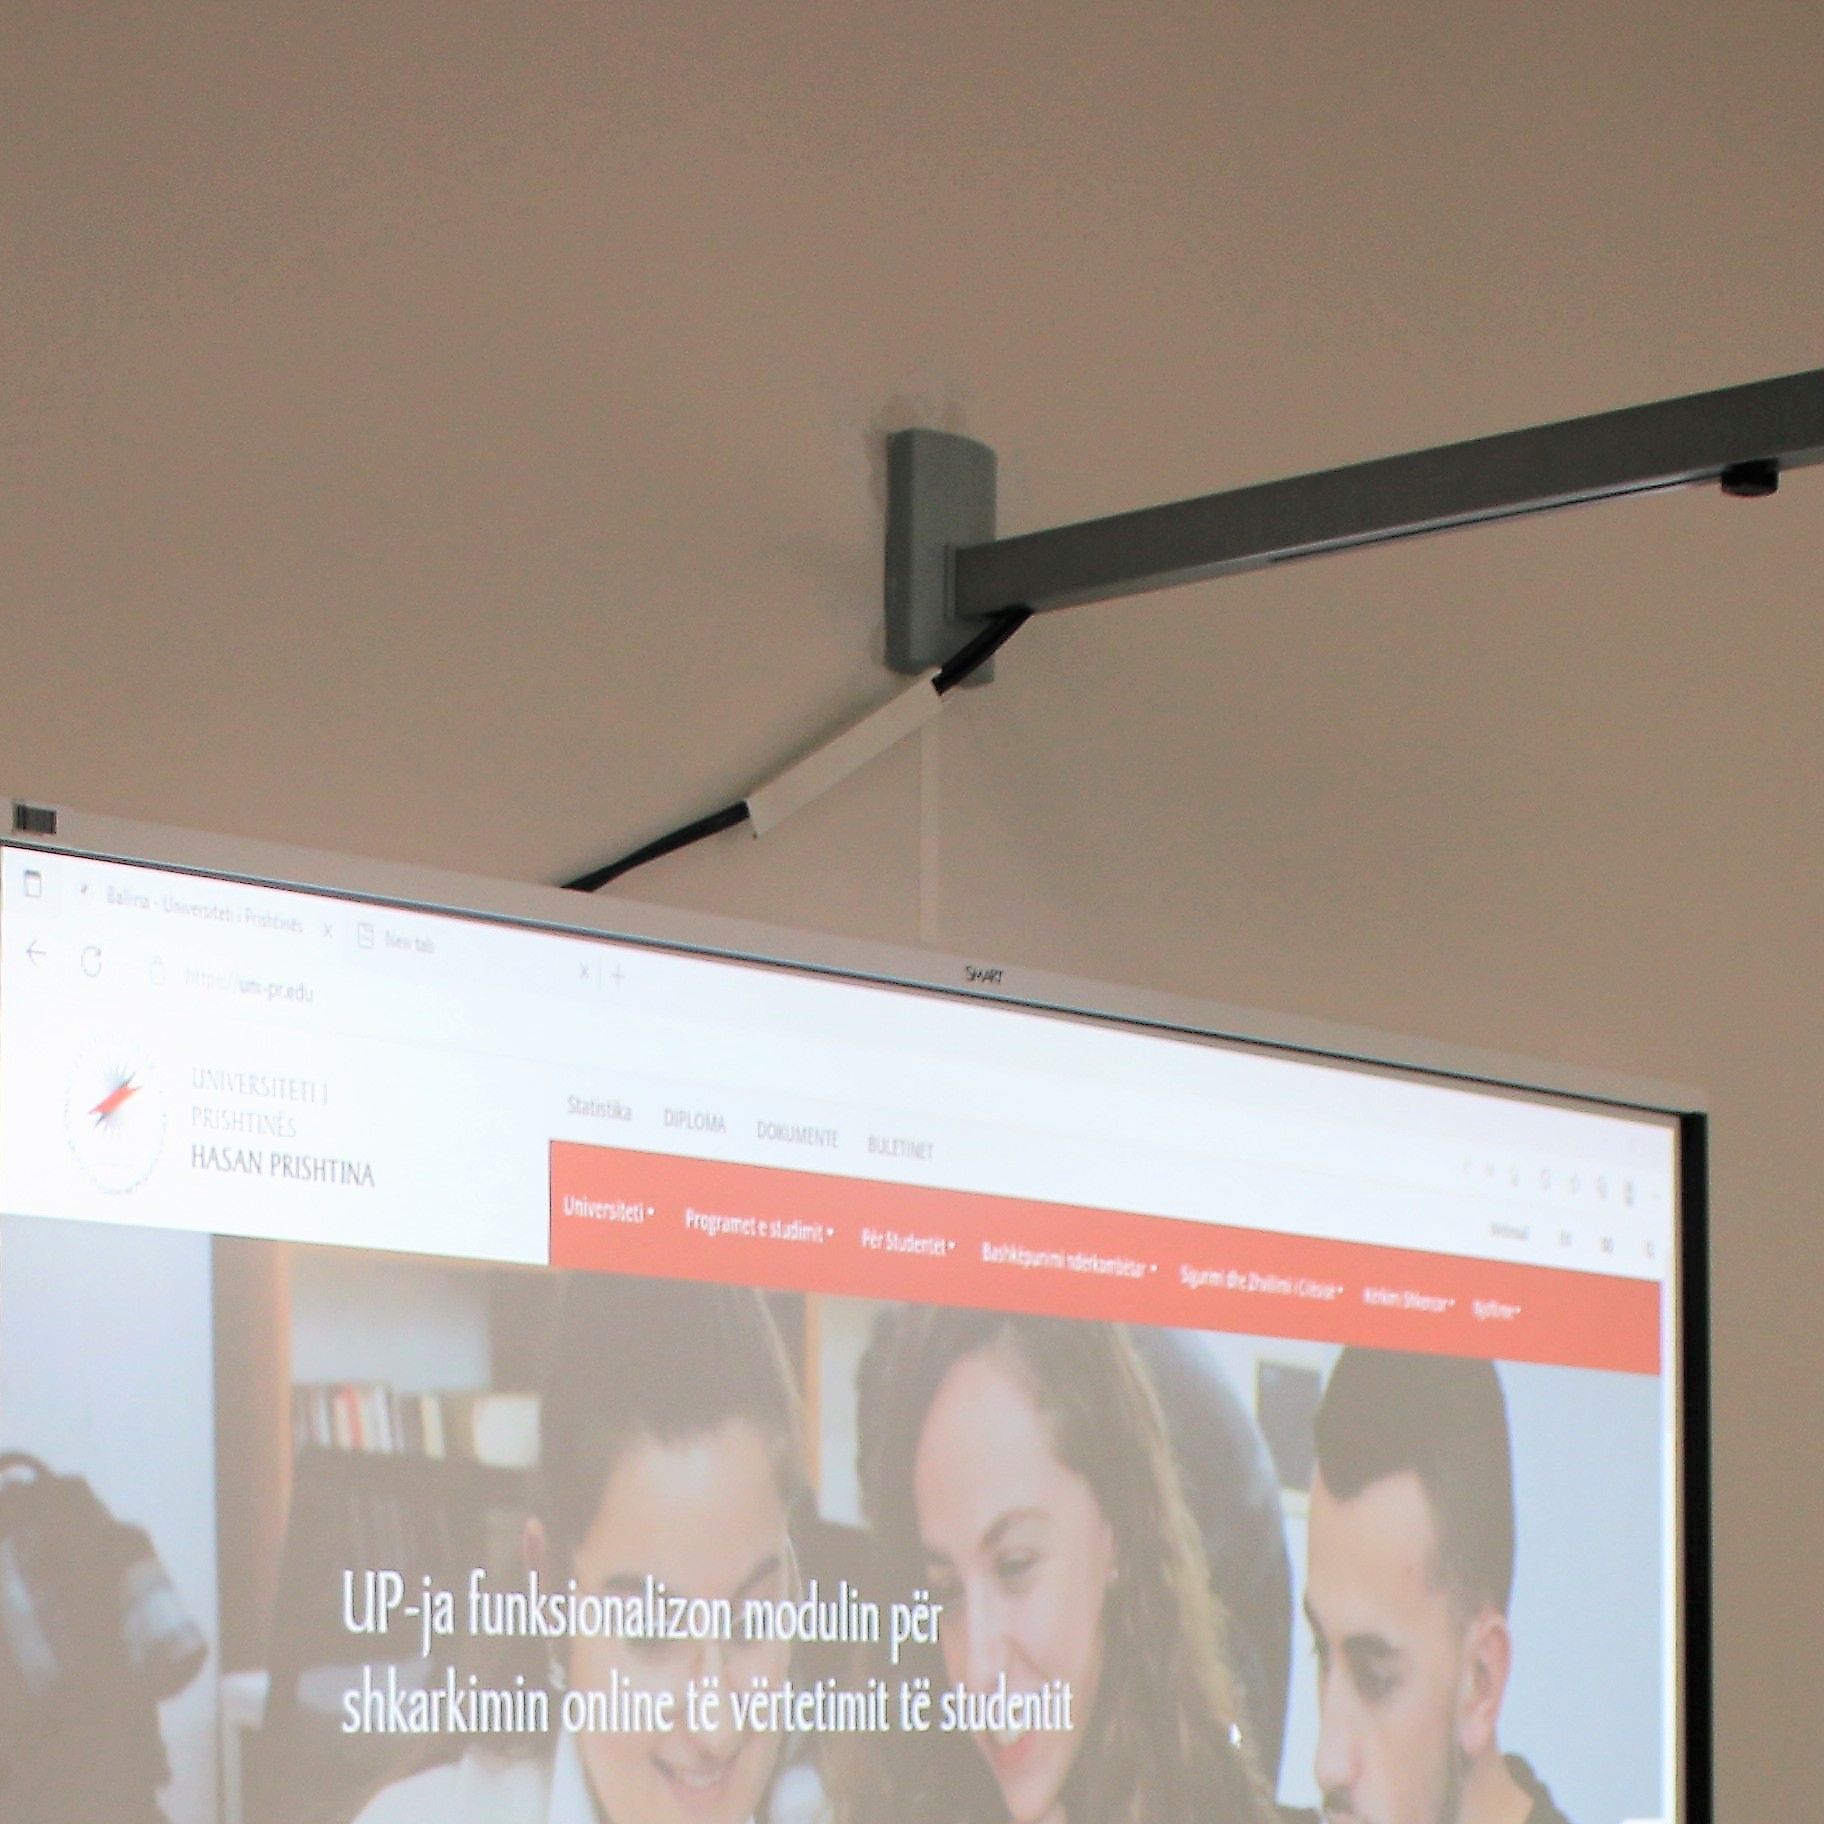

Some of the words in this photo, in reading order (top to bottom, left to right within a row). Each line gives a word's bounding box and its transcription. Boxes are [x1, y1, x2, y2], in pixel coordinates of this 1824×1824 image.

[191, 1066, 316, 1103] UNIVERSITETI
[191, 1105, 297, 1139] PRISHTINËS
[567, 1095, 632, 1122] Statistika
[663, 1107, 727, 1134] DIPLOMA
[756, 1120, 839, 1150] DOKUMENTE
[867, 1135, 934, 1160] BULETINET
[191, 1143, 262, 1176] HASAN
[270, 1151, 376, 1188] PRISHTINA
[563, 1195, 645, 1224] Universiteti
[685, 1208, 756, 1237] Programet
[769, 1216, 824, 1243] studimit
[341, 1567, 455, 1659] UP-ja
[468, 1568, 733, 1642] funksionalizon
[743, 1578, 880, 1643] modulin
[889, 1593, 944, 1664] për
[341, 1665, 549, 1735] shkarkimin
[561, 1668, 675, 1733] online
[685, 1677, 722, 1732] të
[730, 1675, 890, 1733] vërtetimit
[899, 1680, 931, 1732] të
[939, 1672, 1075, 1734] studentit
